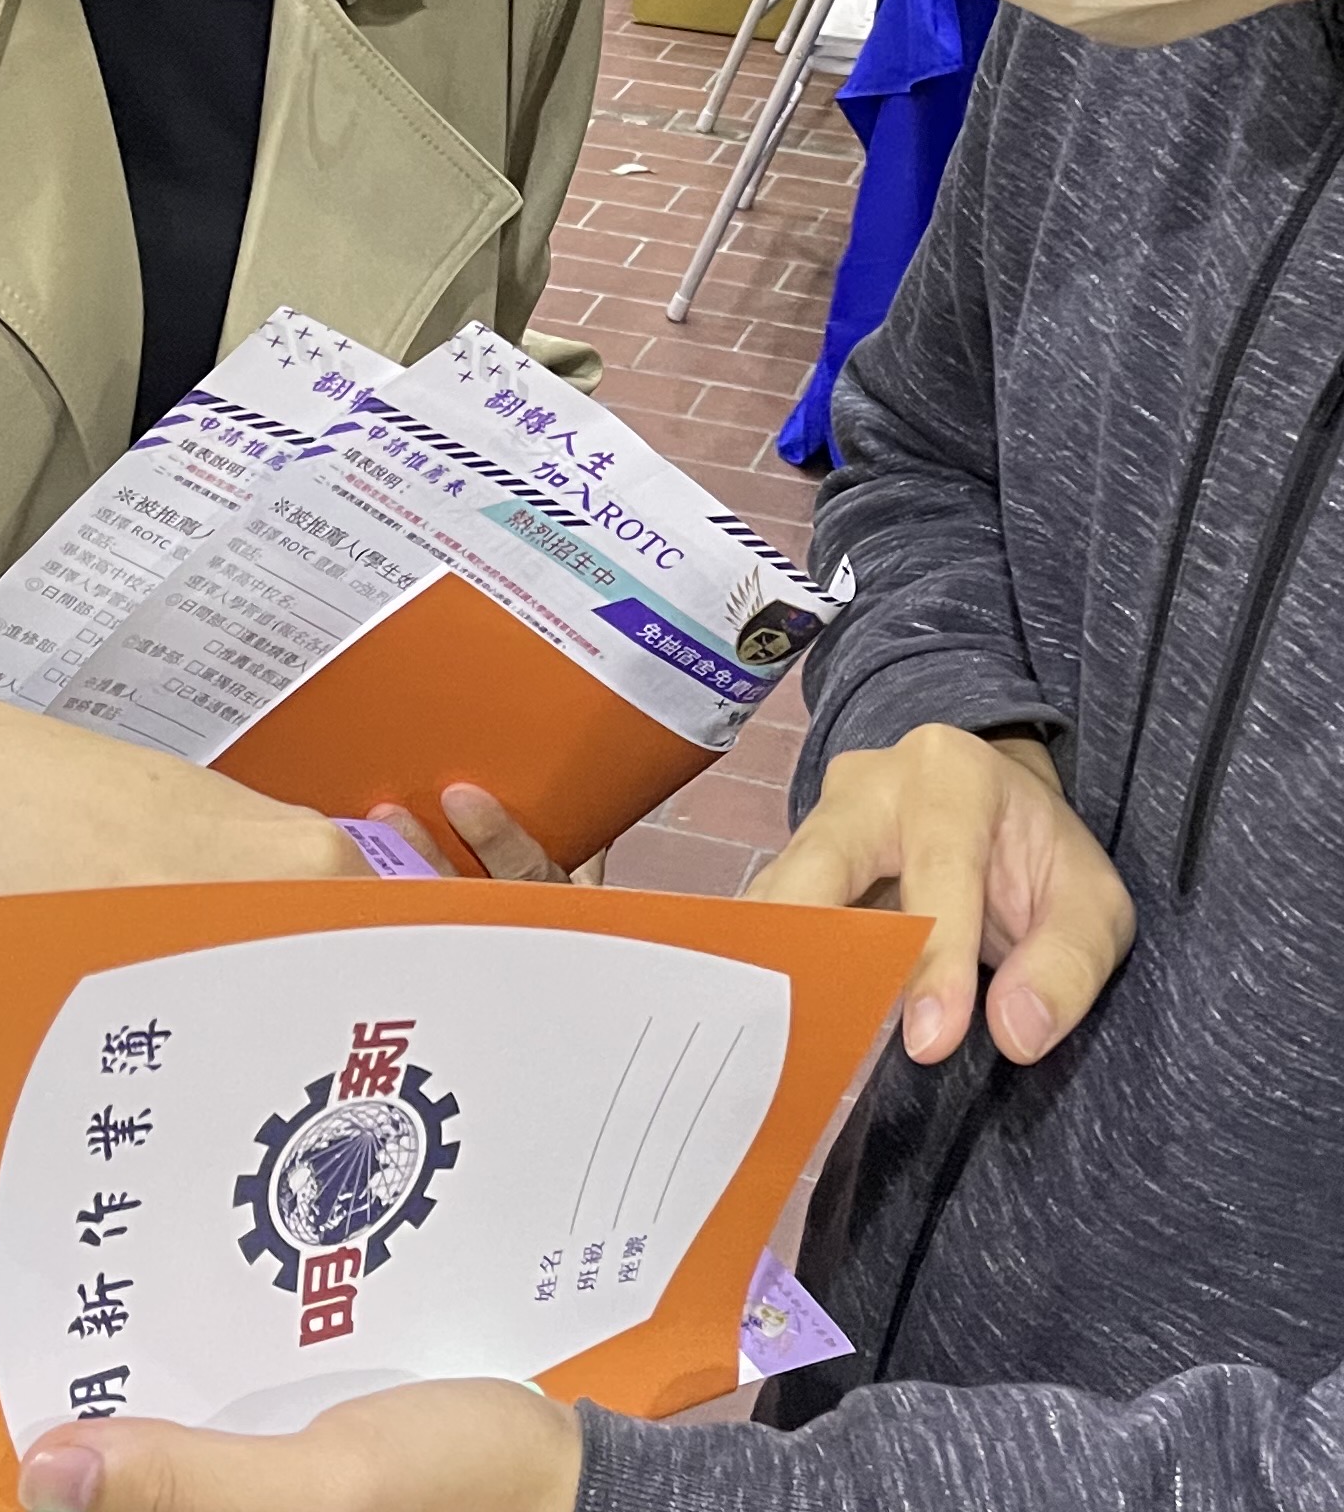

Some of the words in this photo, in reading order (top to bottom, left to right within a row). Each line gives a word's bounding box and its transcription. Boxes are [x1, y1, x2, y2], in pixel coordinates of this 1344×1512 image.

[483, 388, 615, 481] 翻轉人生
[131, 524, 173, 552] ROTC
[505, 508, 617, 587] 熱烈招生中
[530, 461, 685, 571] 加入ROTC
[278, 535, 316, 563] ROTC
[337, 1018, 417, 1102] 新
[534, 1249, 564, 1301] 姓名
[576, 1240, 606, 1291] 班級
[617, 1234, 648, 1284] 座號
[299, 1245, 362, 1348] 明
